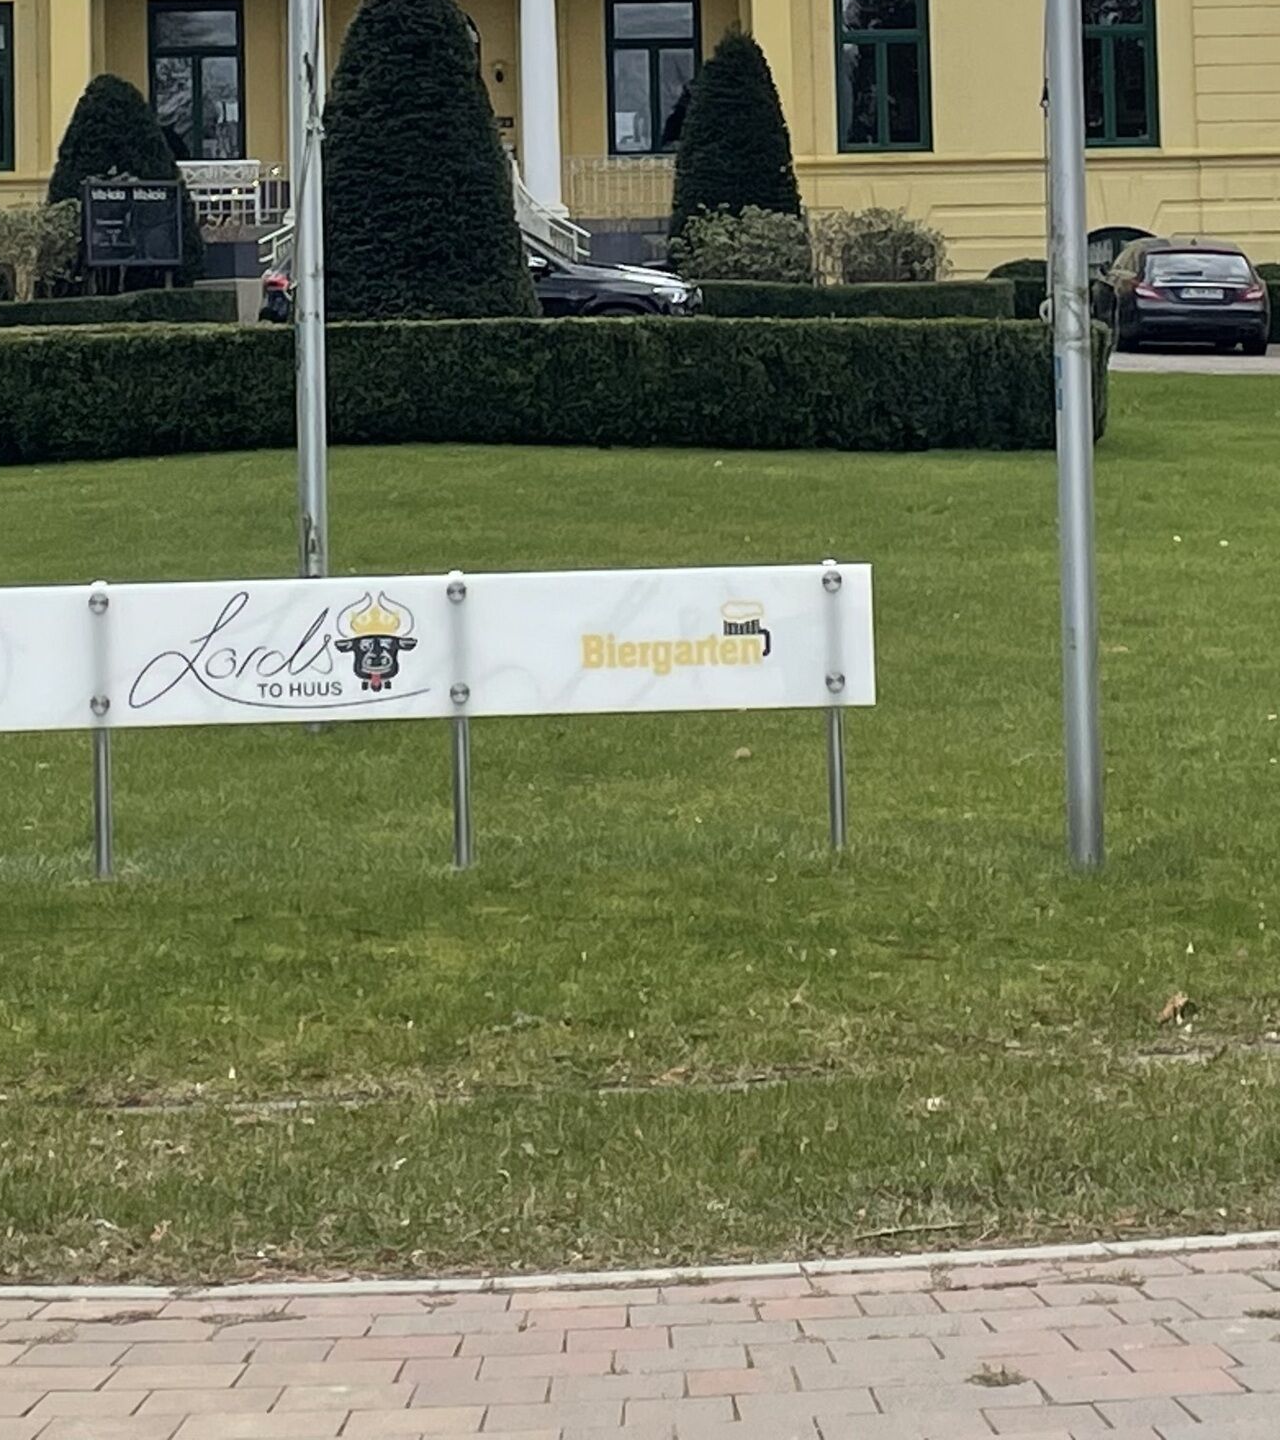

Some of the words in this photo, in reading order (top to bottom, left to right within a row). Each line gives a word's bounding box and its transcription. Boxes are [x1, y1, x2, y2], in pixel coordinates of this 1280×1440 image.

[128, 591, 333, 708] Lords
[581, 633, 763, 675] Biergarten
[258, 683, 282, 698] TO
[289, 681, 343, 696] HUUS
